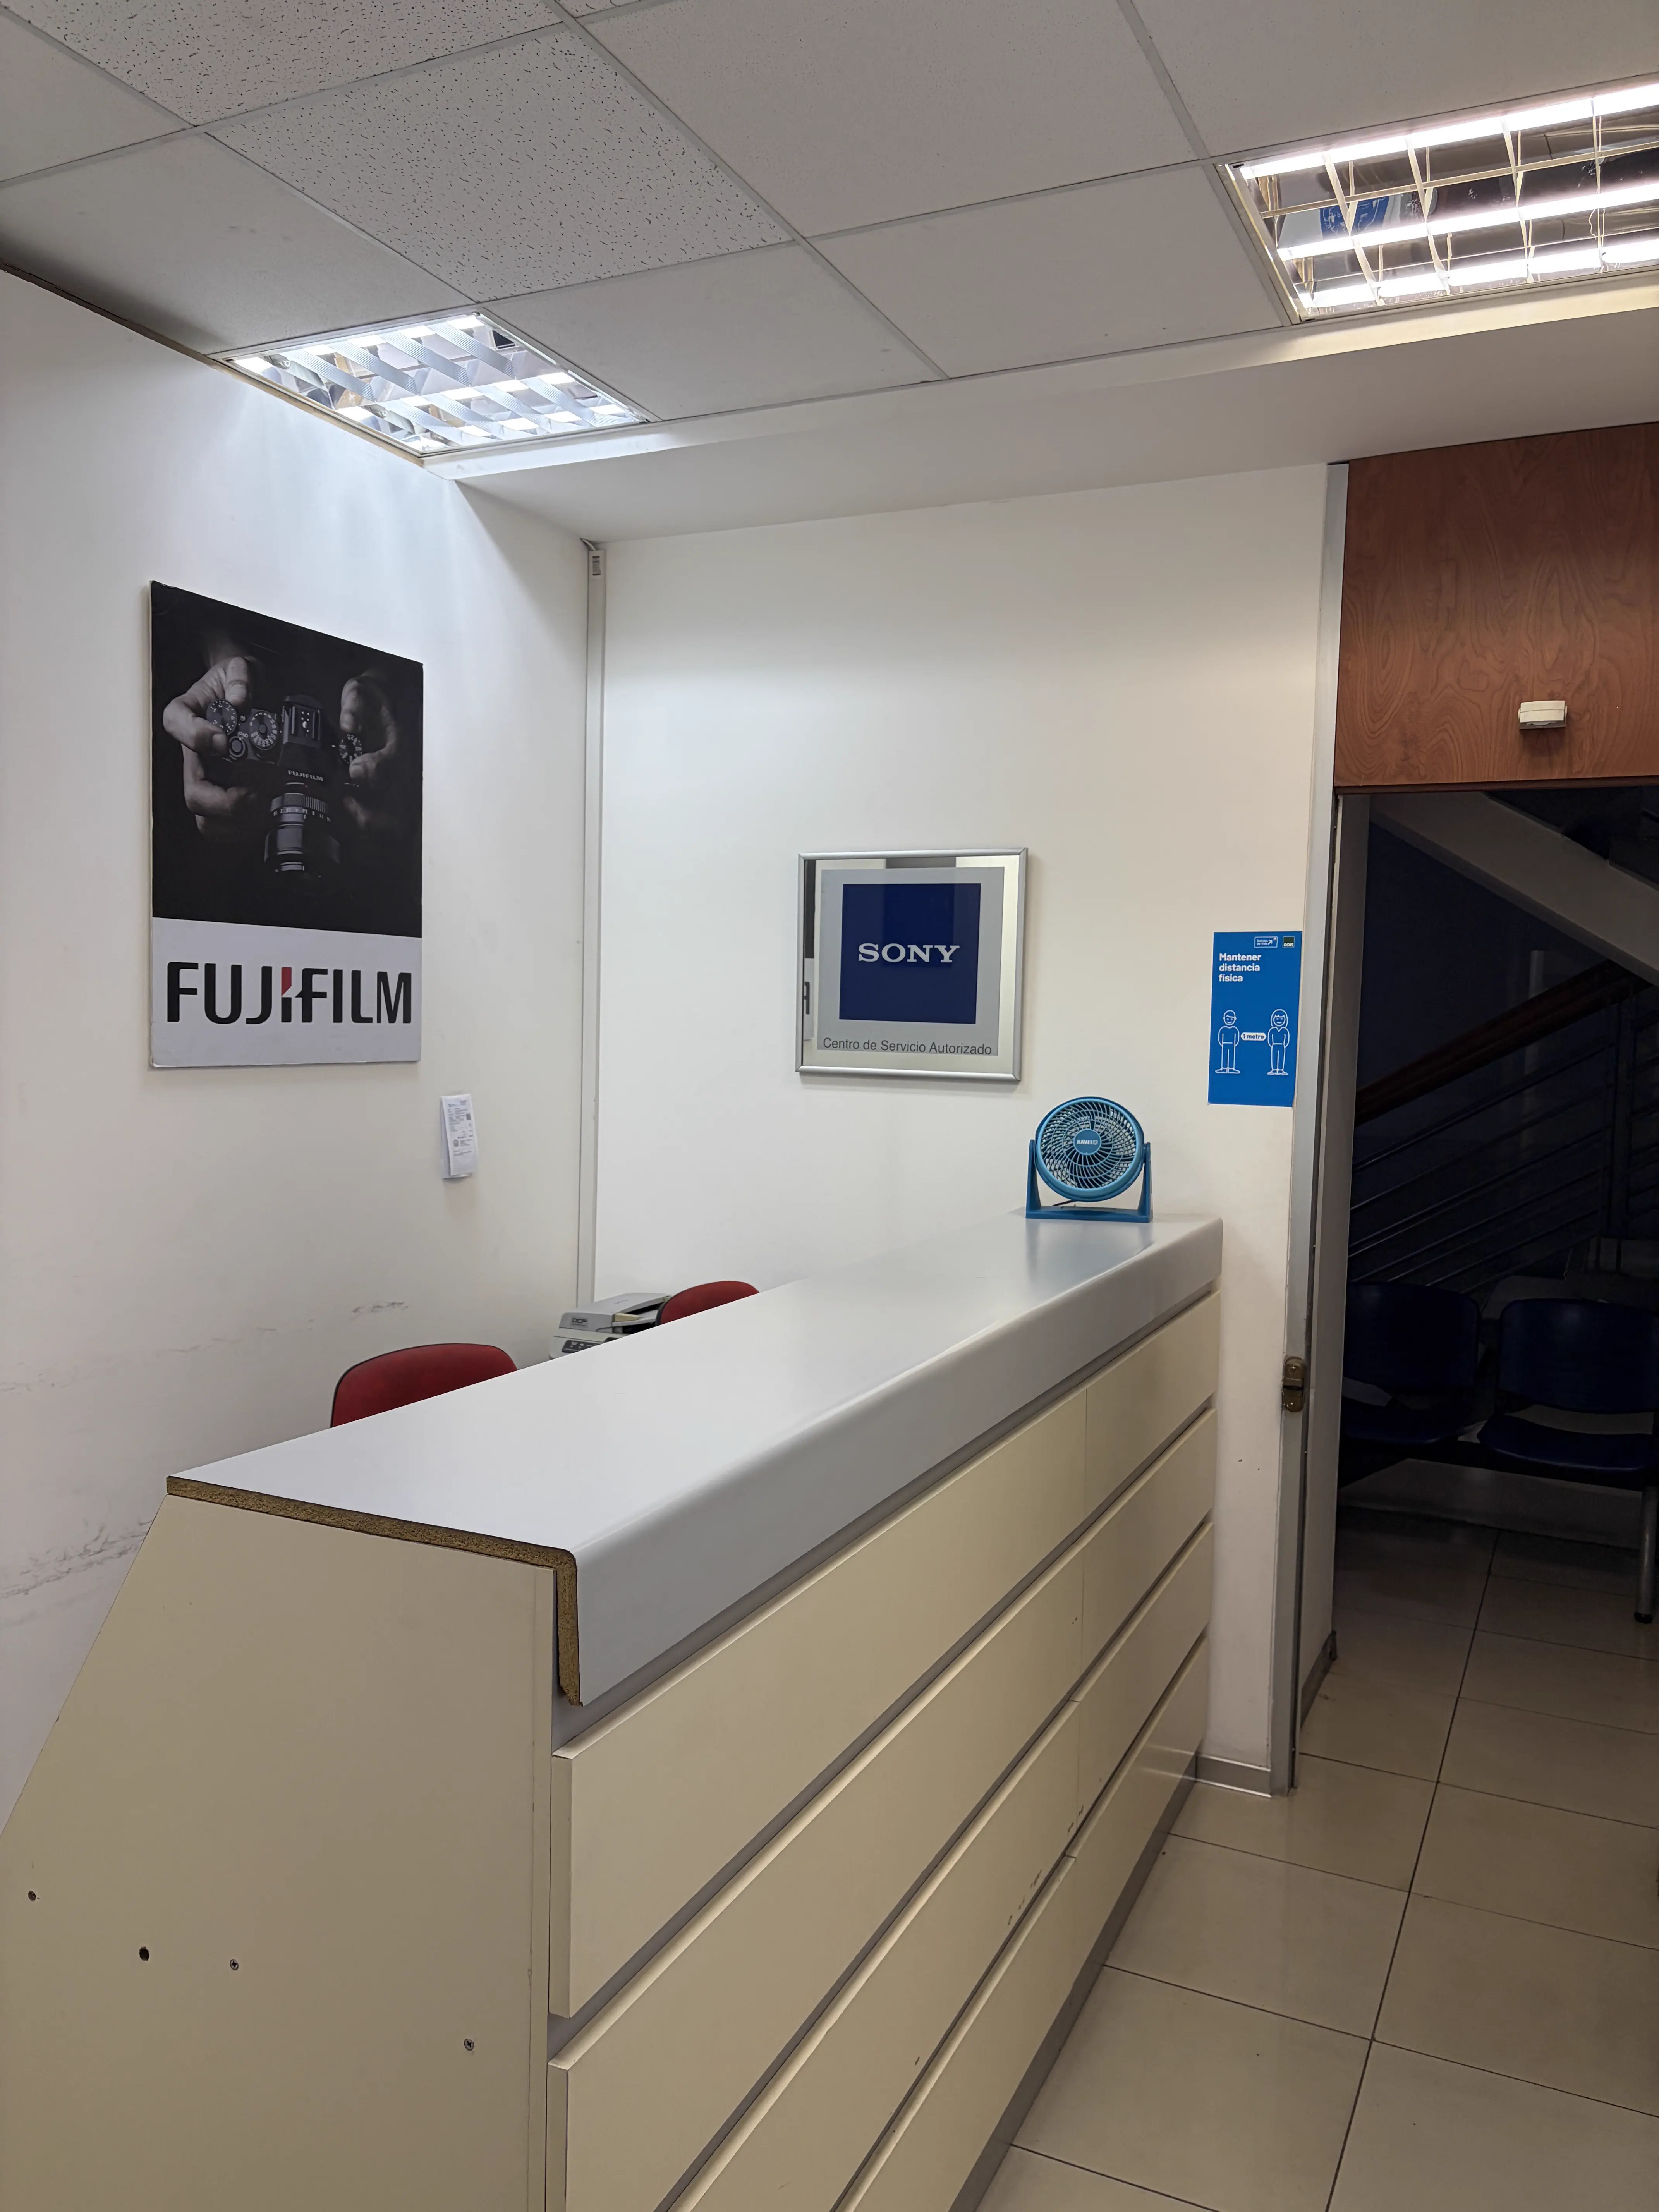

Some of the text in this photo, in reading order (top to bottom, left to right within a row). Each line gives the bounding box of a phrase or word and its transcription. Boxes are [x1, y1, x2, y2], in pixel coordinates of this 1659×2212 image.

[288, 770, 323, 781] FUJIFILM
[858, 943, 960, 963] SONY
[1219, 953, 1262, 961] Mantener
[1219, 963, 1260, 972] distancia
[1218, 973, 1243, 982] física
[167, 962, 412, 1024] FUJIFILM
[823, 1037, 992, 1055] Centro de Servicio Autorizado
